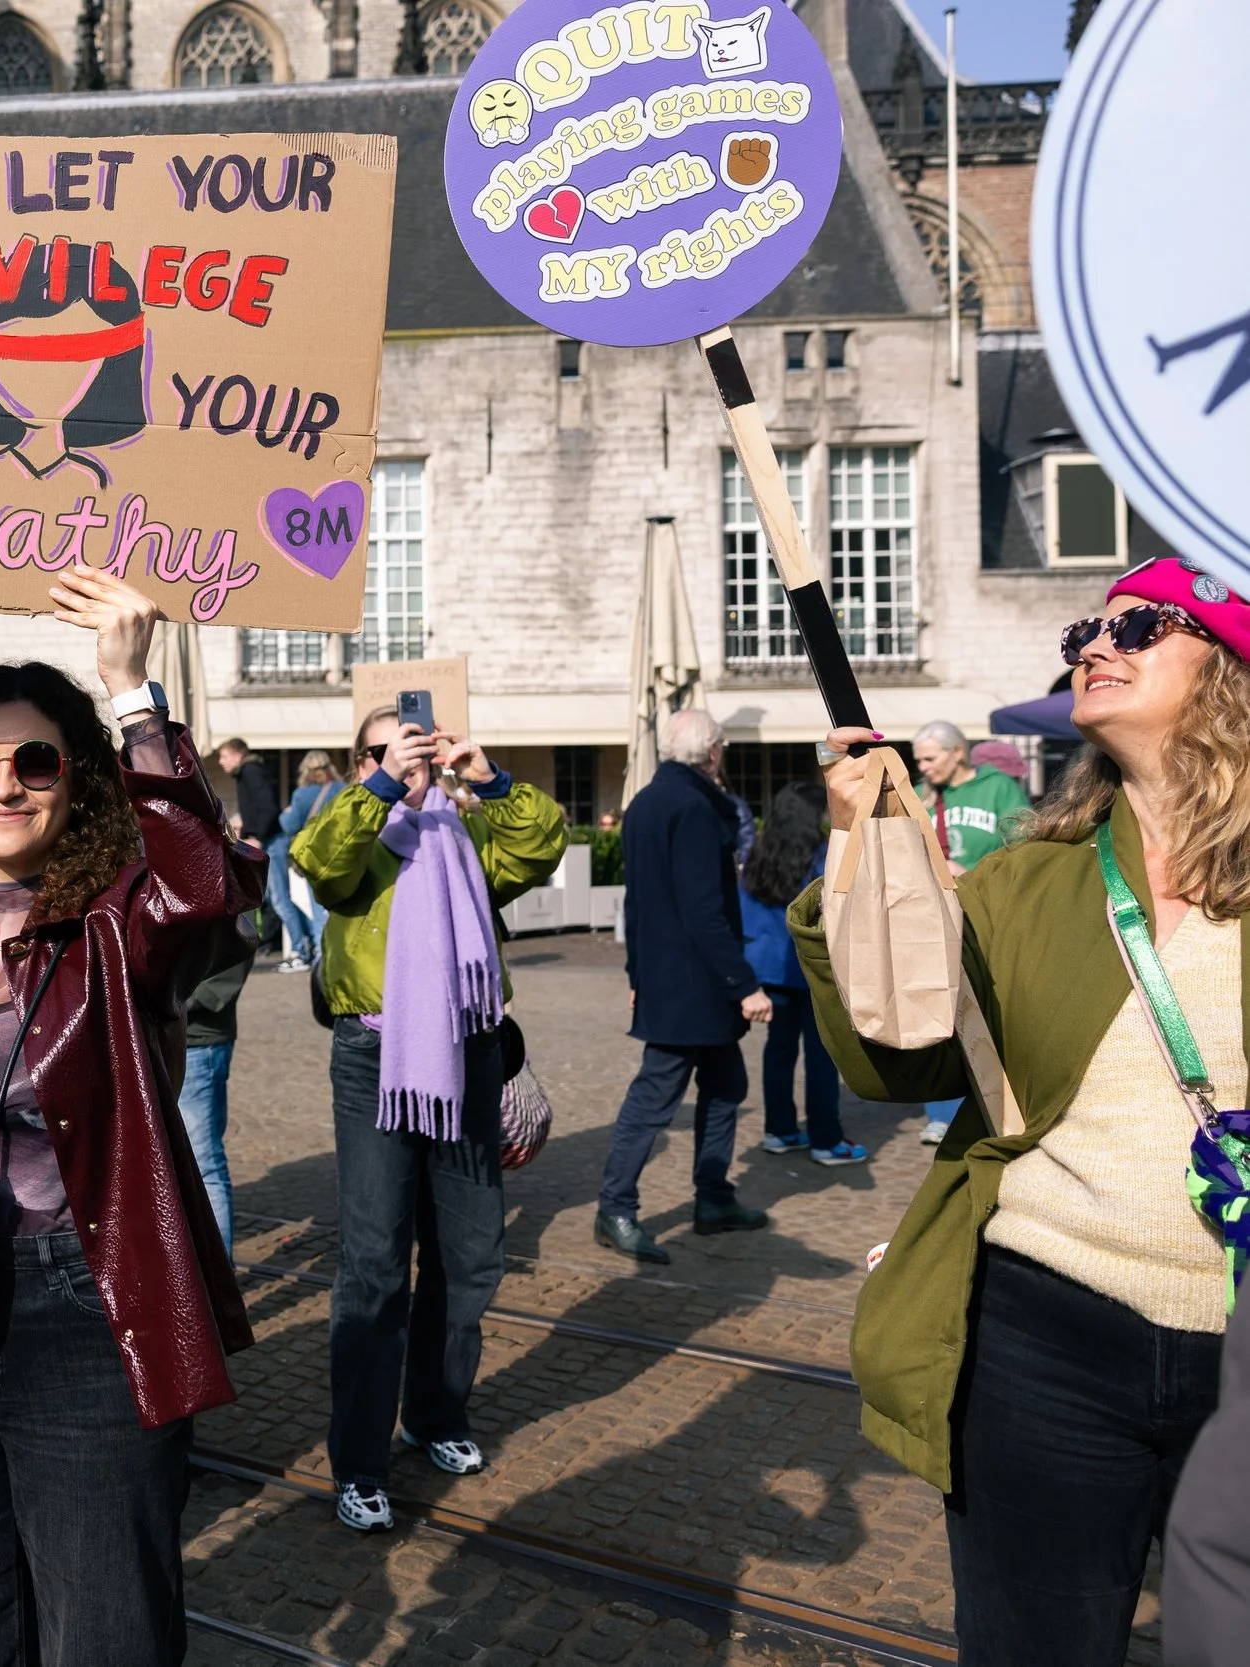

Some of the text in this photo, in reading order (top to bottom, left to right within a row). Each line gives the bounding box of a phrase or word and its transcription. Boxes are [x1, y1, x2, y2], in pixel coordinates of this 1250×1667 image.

[524, 5, 704, 103] QUIT
[7, 150, 135, 214] LET
[167, 152, 337, 214] YOUR
[480, 87, 805, 225] playing games
[592, 157, 709, 217] with
[545, 187, 797, 296] MY rights
[168, 371, 341, 460] YOUR
[285, 507, 354, 547] 8M
